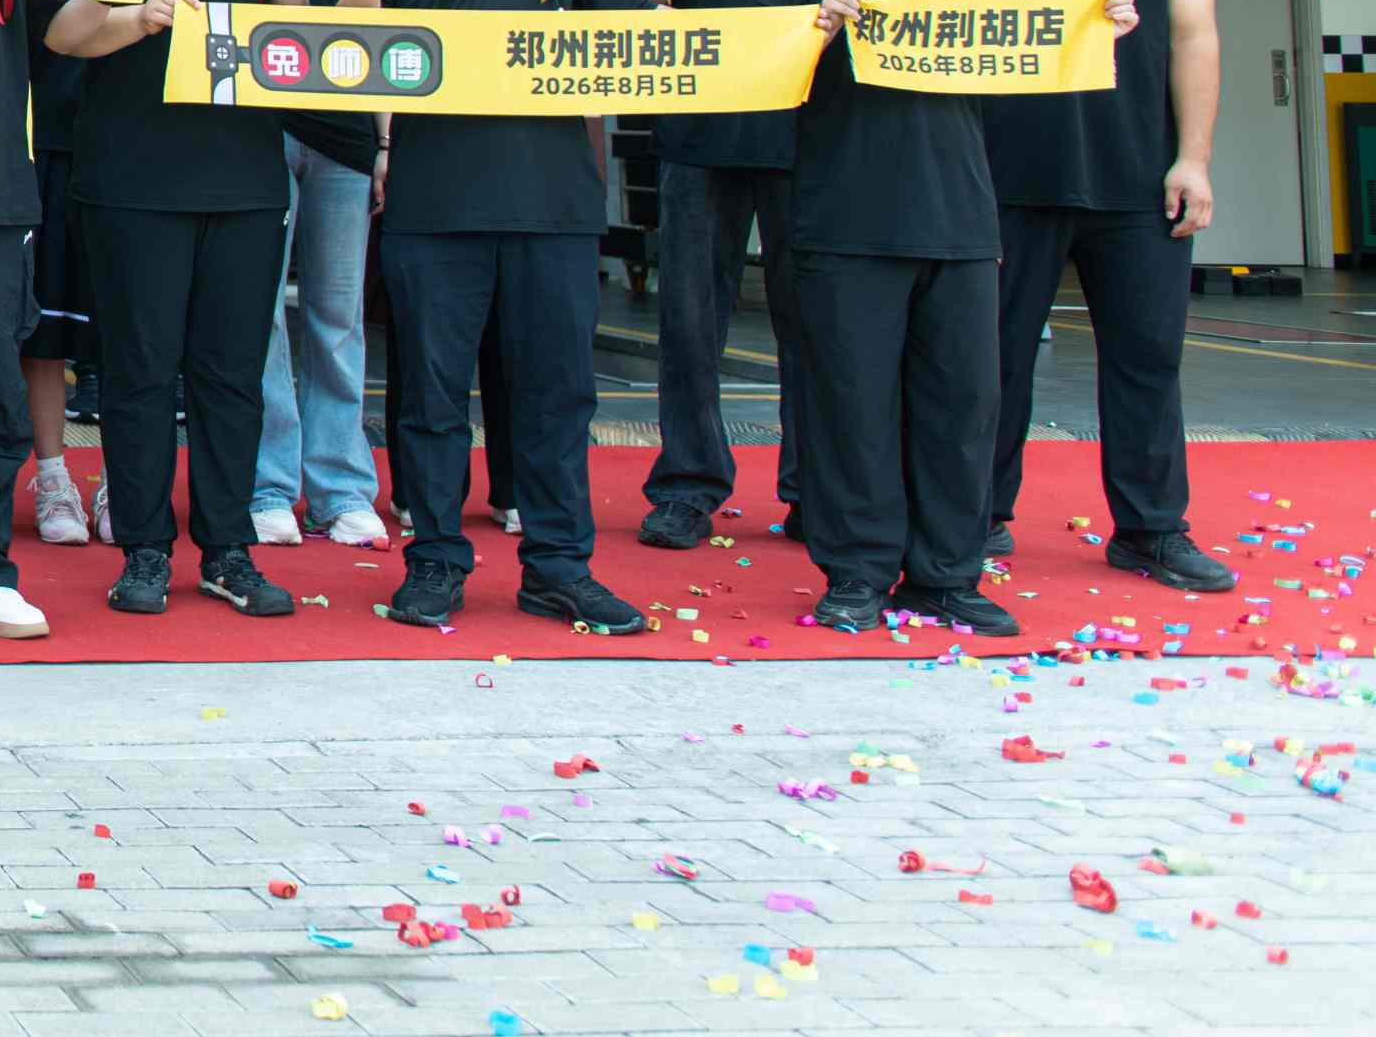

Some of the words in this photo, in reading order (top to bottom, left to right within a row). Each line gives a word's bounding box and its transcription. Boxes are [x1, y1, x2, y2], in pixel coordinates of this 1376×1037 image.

[853, 7, 1065, 47] 郑州荆胡店
[505, 27, 721, 69] 郑州荆胡店
[877, 52, 1041, 77] 2026年8月5日
[531, 75, 698, 97] 2026年8月5日
